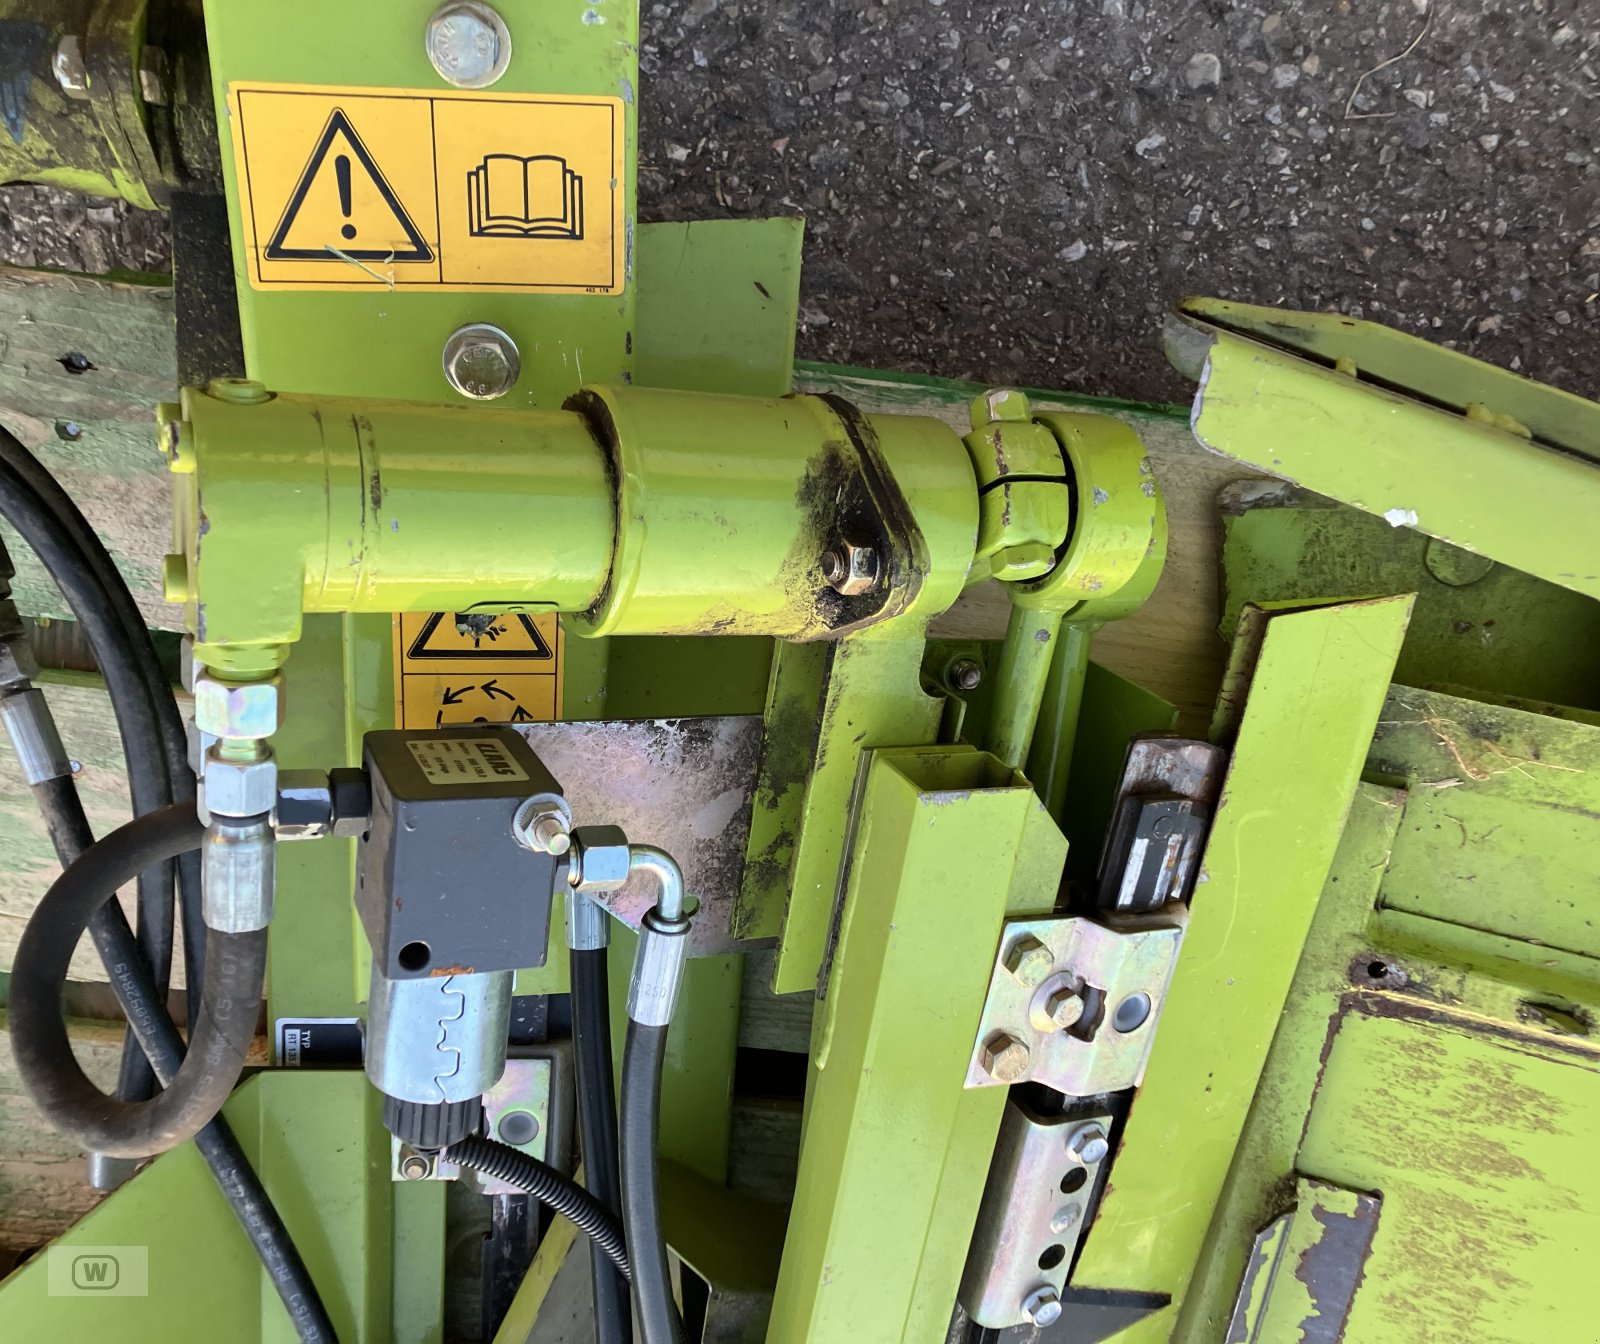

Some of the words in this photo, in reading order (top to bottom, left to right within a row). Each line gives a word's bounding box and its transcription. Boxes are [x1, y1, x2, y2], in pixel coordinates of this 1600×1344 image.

[475, 743, 516, 775] CLAAS
[287, 1033, 297, 1045] RT
[301, 1030, 311, 1049] TYP
